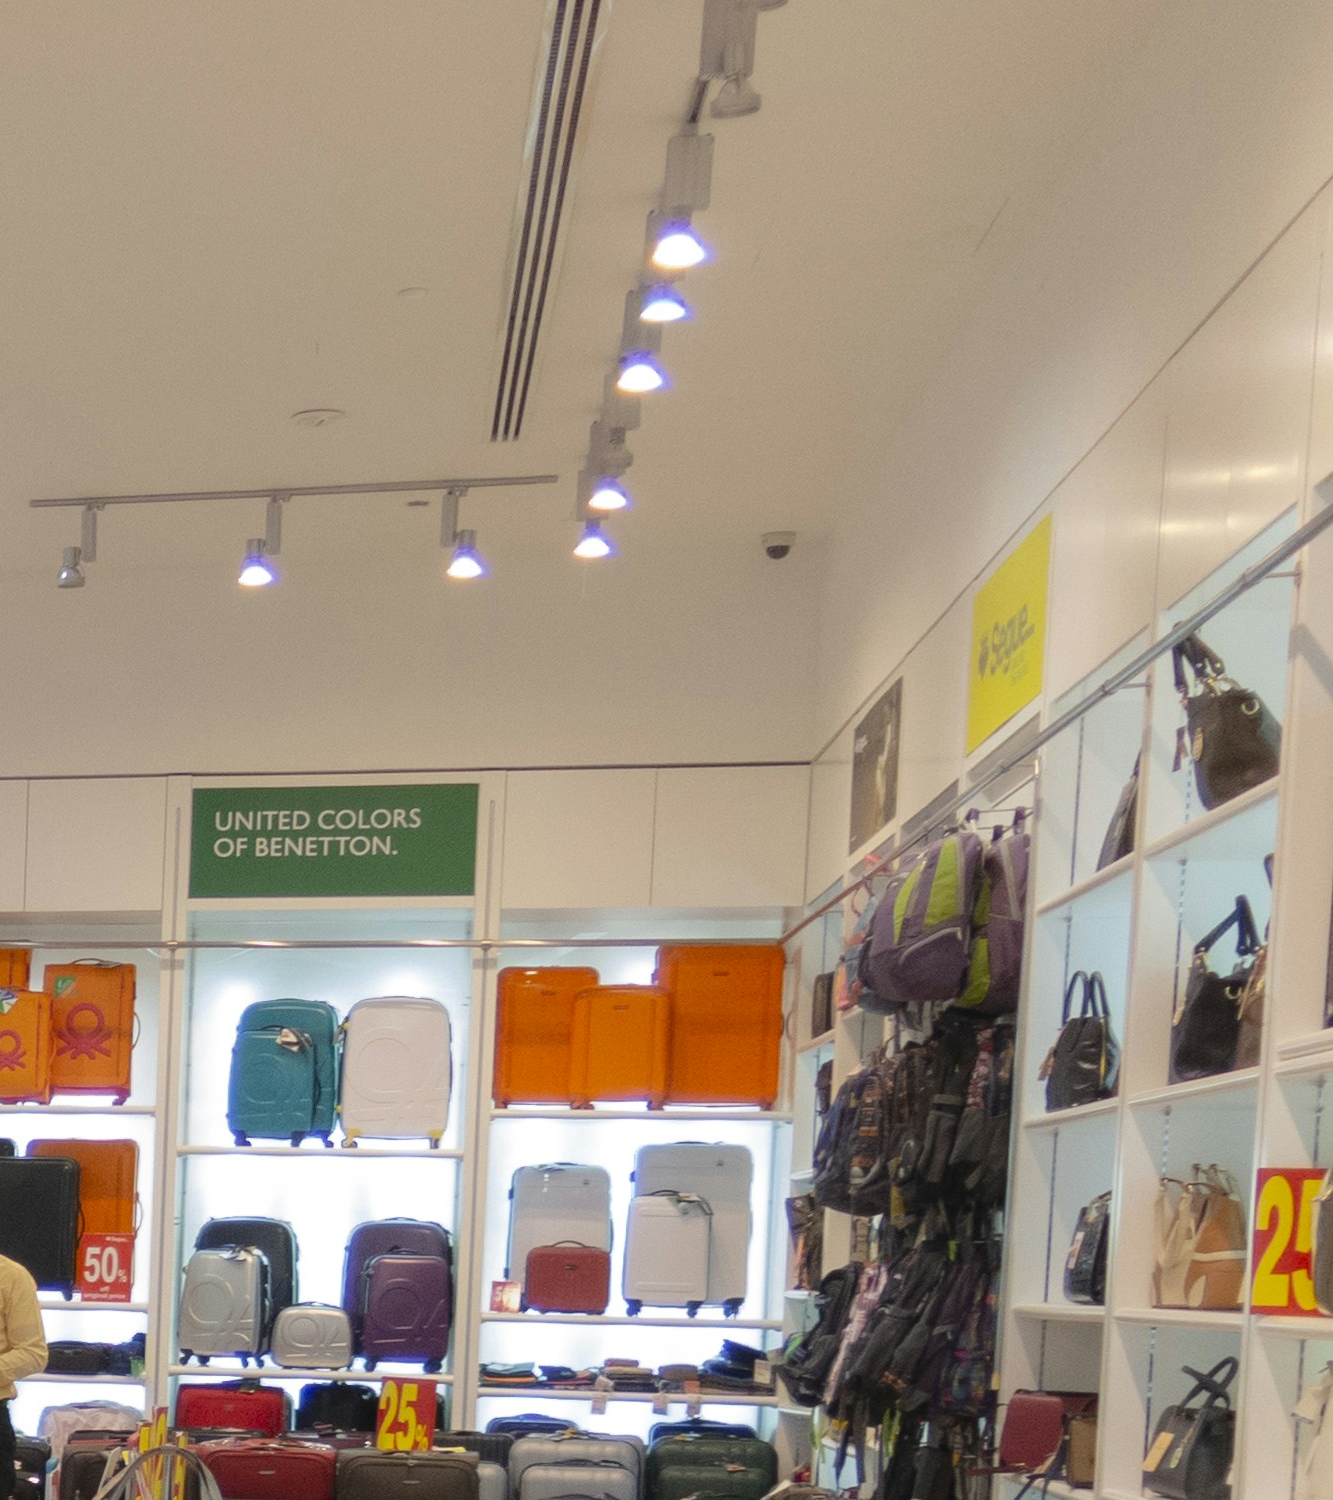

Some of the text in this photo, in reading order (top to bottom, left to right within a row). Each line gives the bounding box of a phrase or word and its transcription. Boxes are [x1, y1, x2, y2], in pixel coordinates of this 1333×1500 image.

[214, 807, 422, 832] UNITED COLORS
[213, 835, 399, 858] OF BENETTON.
[83, 1246, 128, 1284] 50%
[376, 1379, 429, 1451] 25%
